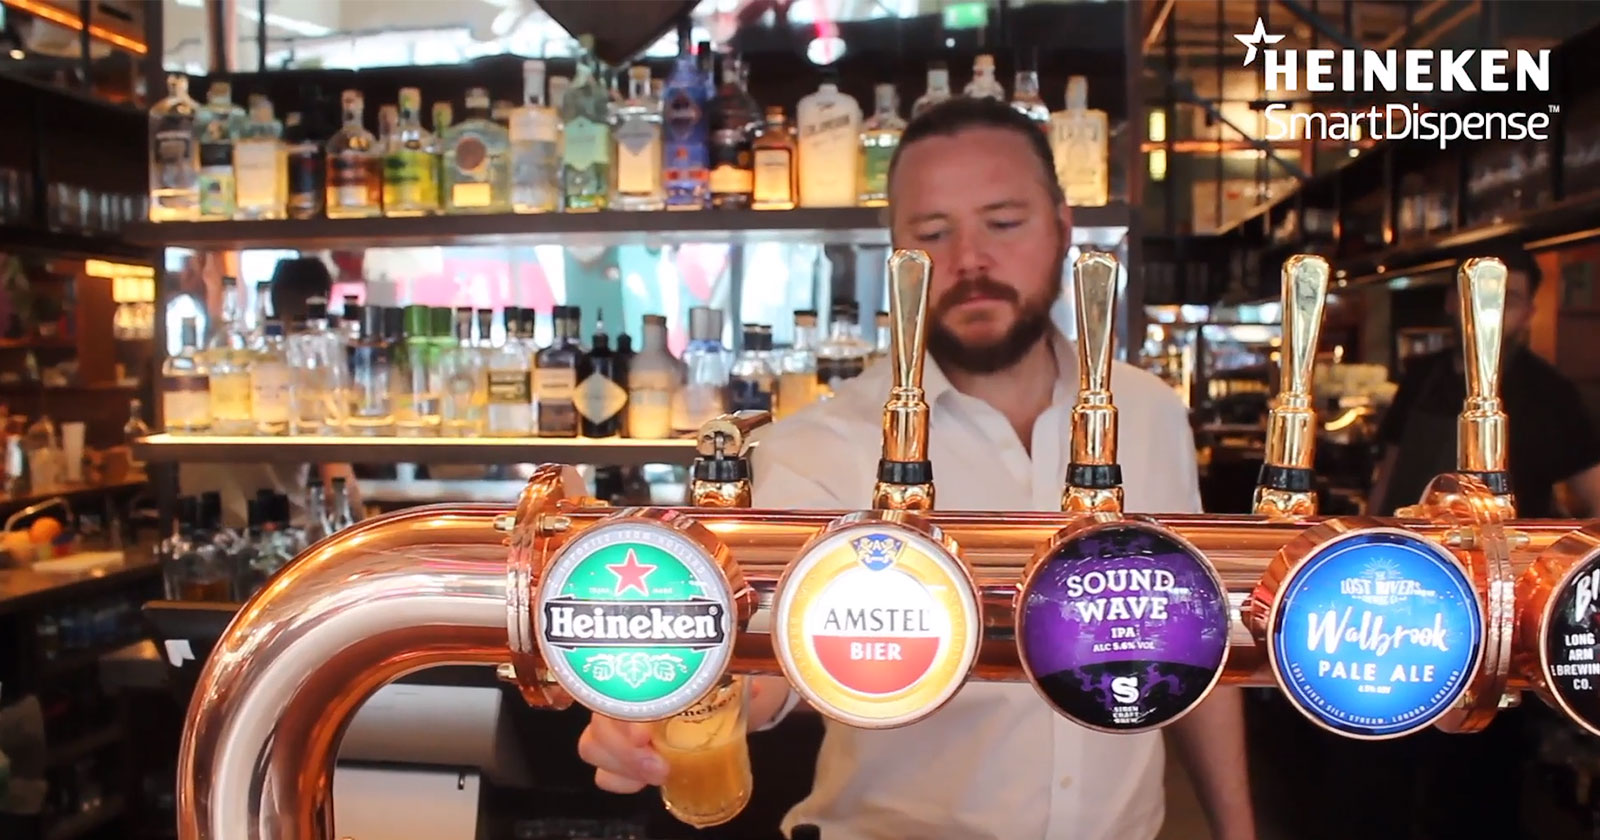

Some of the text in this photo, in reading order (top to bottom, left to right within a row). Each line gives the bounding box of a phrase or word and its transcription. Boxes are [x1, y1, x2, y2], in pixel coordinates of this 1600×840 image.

[1066, 569, 1175, 598] SOUND
[1341, 578, 1371, 595] LOST
[1575, 568, 1600, 622] BI
[1076, 597, 1168, 623] WAVE
[824, 608, 930, 632] AMSTEL
[1111, 627, 1136, 639] IPA
[1307, 606, 1449, 657] Walbrook
[1565, 633, 1595, 646] LONG
[850, 642, 902, 661] BIER
[1093, 643, 1111, 652] ALC
[1137, 641, 1156, 650] VOL
[1568, 648, 1593, 660] ARM
[1318, 660, 1435, 682] PALE ALE
[1556, 663, 1600, 676] BREWIN
[1573, 678, 1592, 690] CO.
